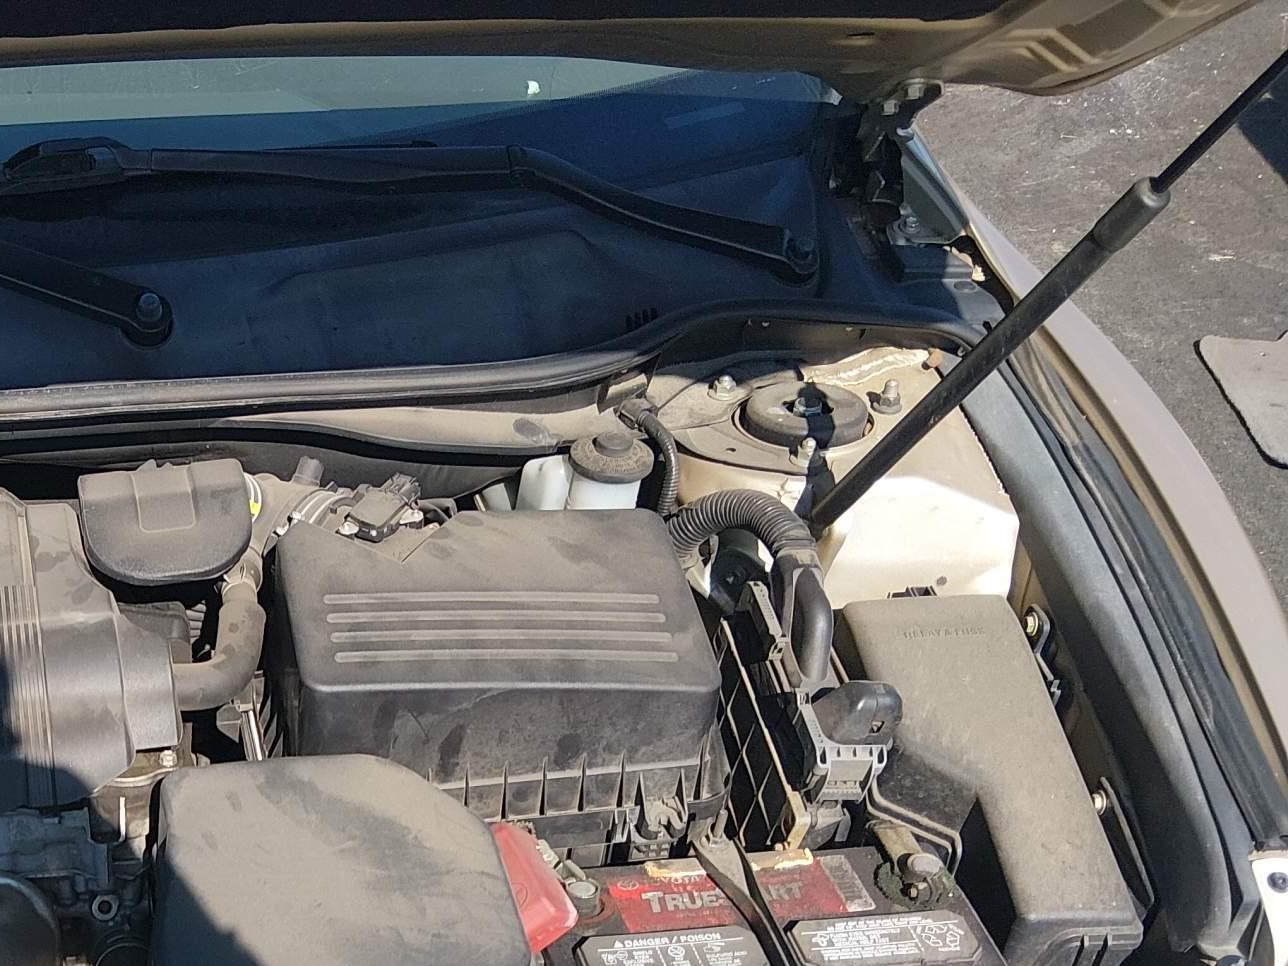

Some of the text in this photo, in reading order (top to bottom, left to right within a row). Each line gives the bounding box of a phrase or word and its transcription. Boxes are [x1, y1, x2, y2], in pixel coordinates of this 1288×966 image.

[642, 882, 802, 913] TRUERT
[624, 936, 669, 948] DANGER
[680, 933, 721, 944] POISON
